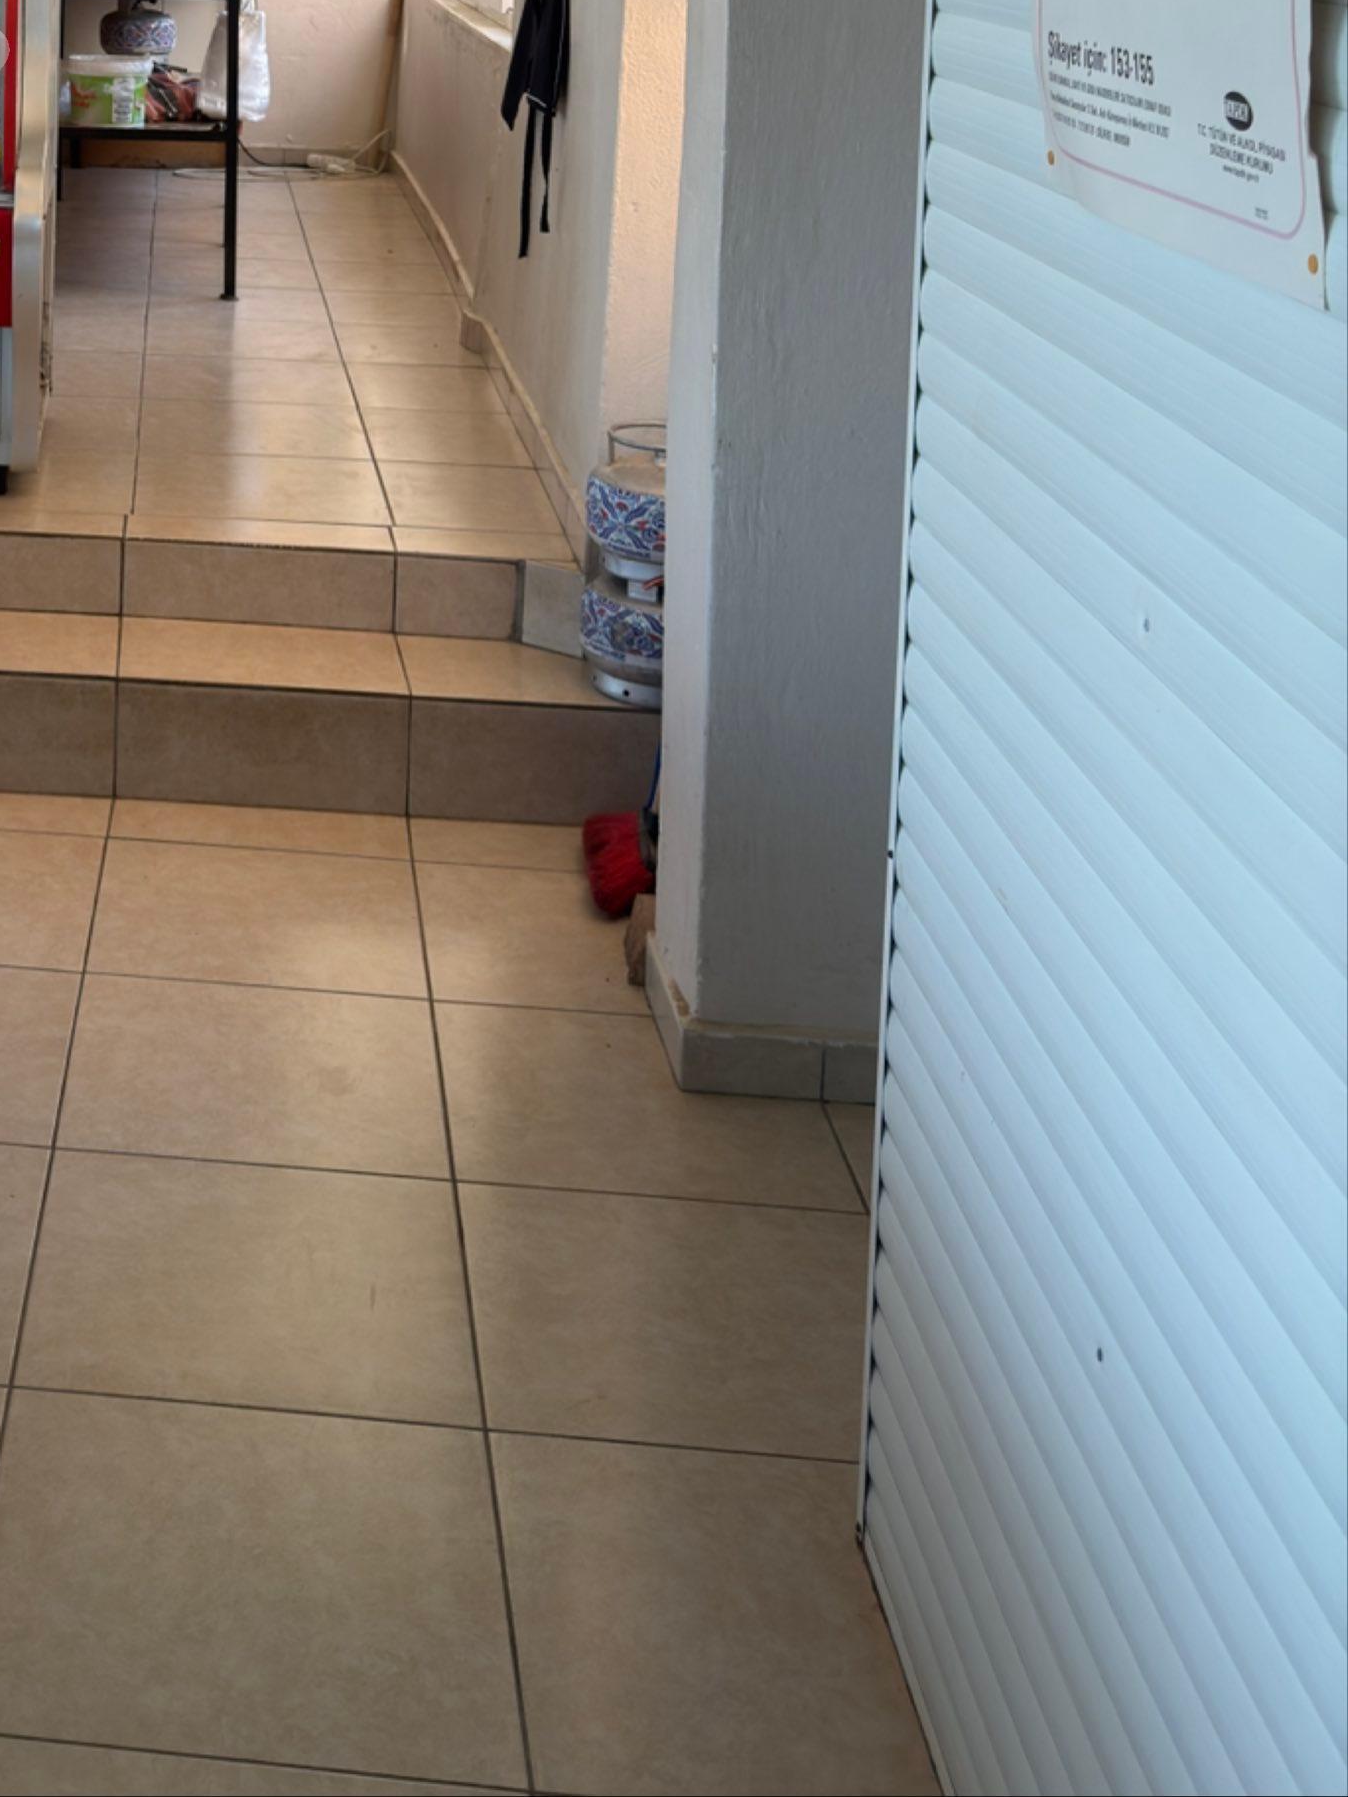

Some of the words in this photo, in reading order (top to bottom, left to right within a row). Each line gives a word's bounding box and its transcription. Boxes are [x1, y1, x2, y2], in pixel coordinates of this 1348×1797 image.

[1048, 30, 1082, 70] Şikayet
[1082, 40, 1108, 77] için:
[1110, 46, 1156, 86] 153-155
